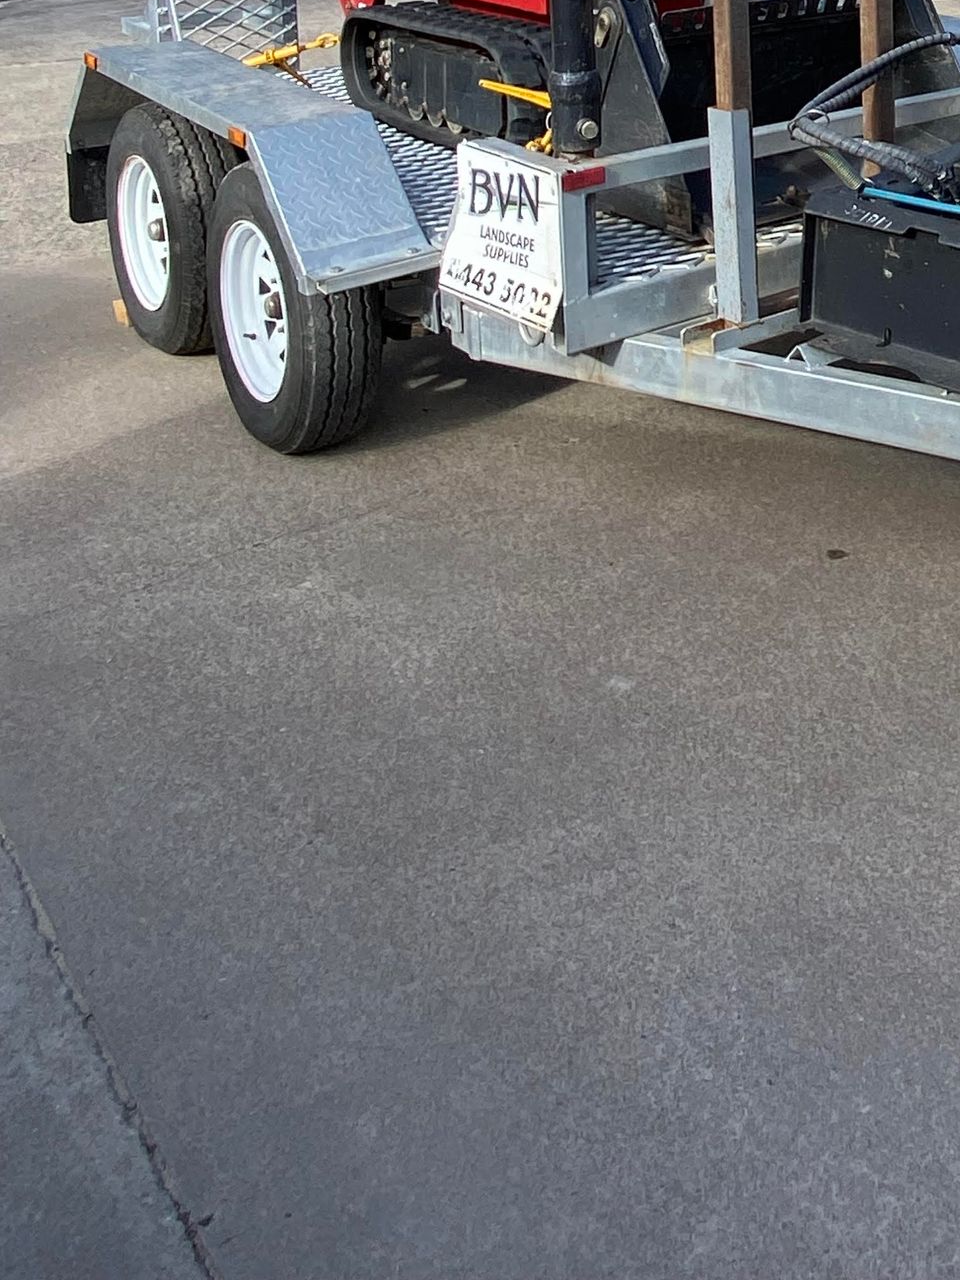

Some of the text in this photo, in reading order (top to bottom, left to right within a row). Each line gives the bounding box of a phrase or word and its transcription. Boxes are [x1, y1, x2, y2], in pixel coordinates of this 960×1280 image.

[468, 167, 540, 224] BVN
[480, 224, 535, 252] LANDSCAPE
[482, 243, 529, 269] SUPPLIES
